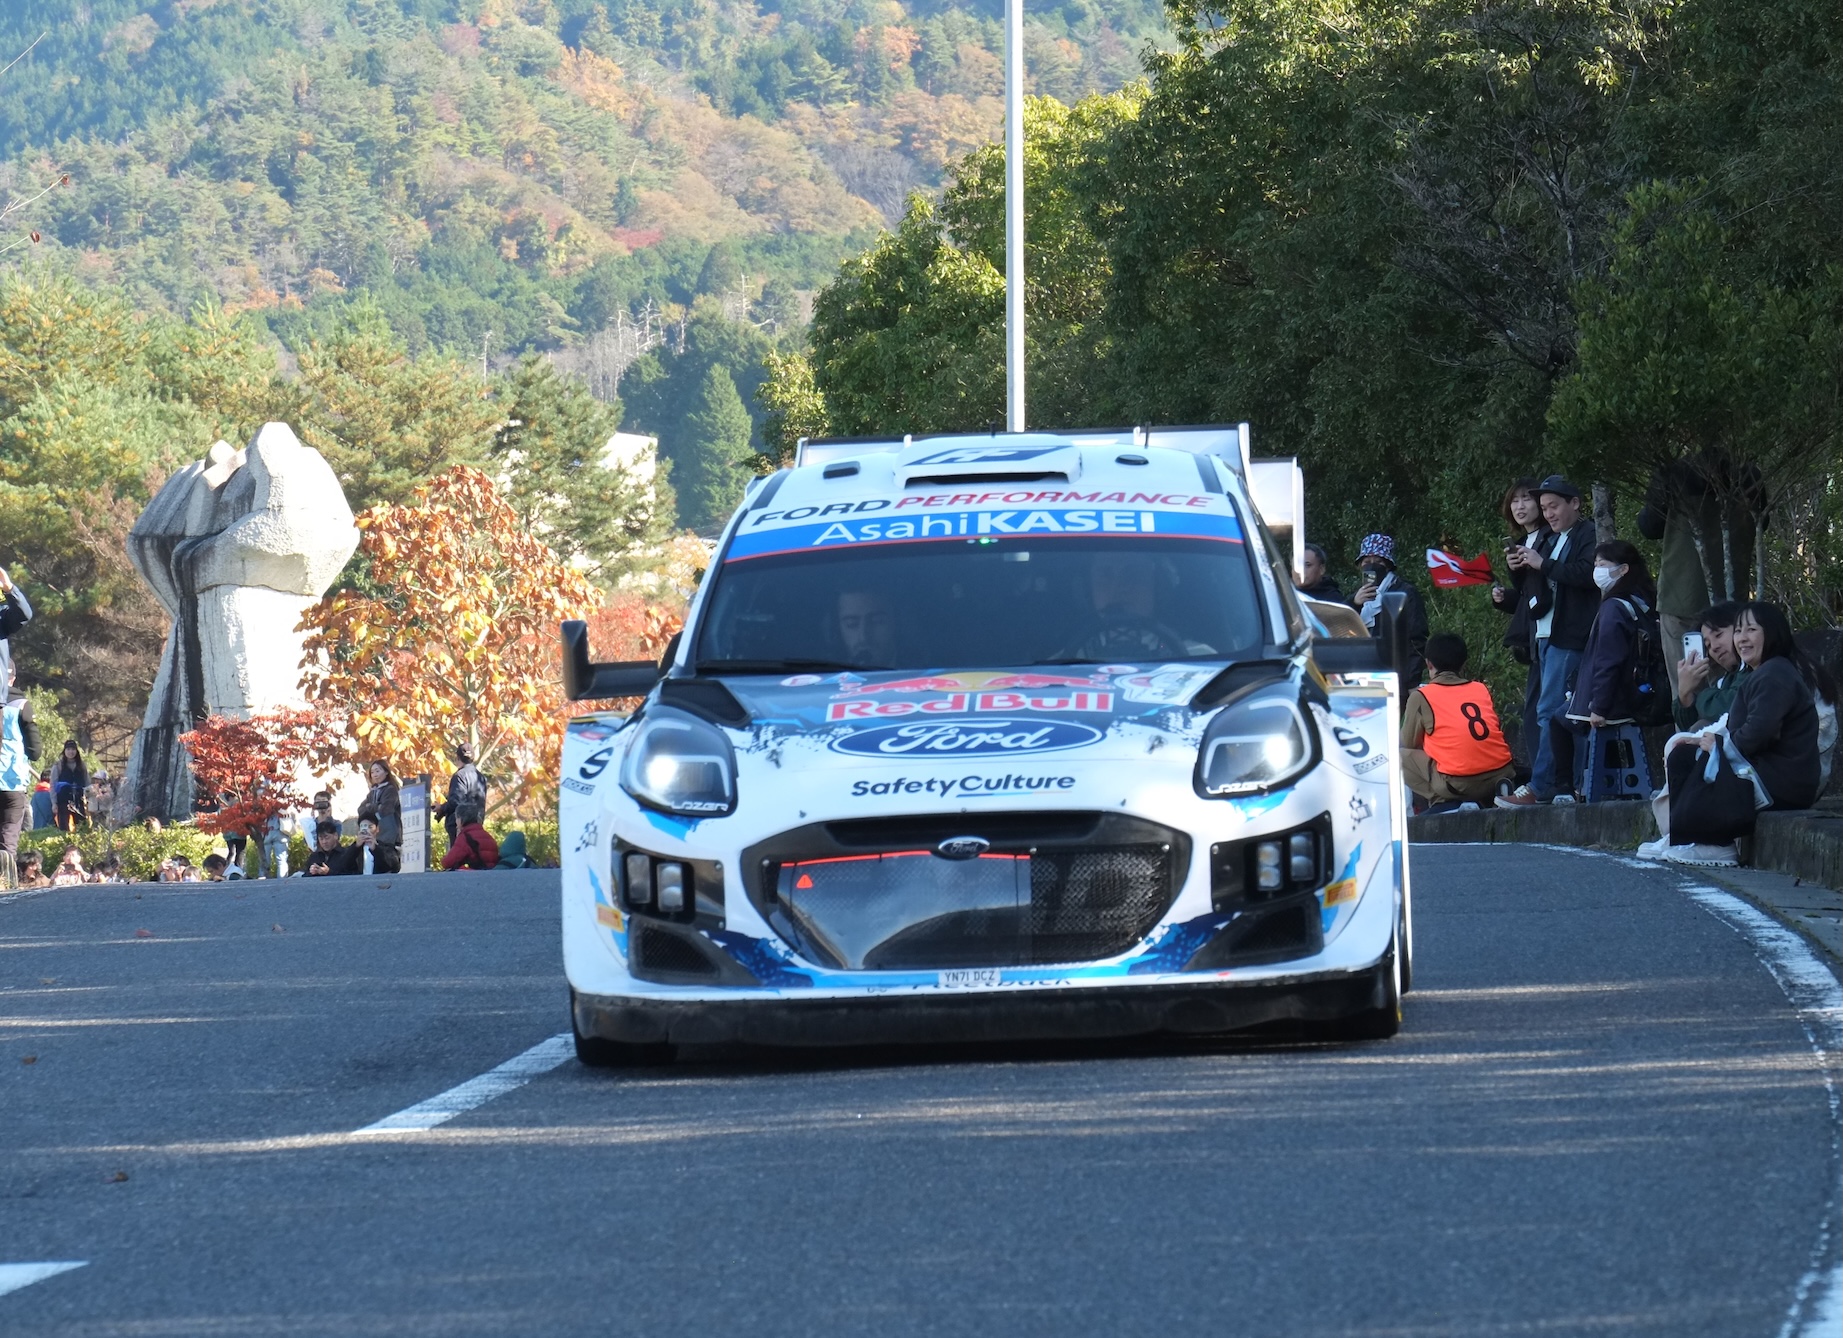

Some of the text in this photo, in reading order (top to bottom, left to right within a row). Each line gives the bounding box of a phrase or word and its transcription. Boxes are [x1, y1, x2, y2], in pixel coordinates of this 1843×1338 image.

[752, 491, 1214, 526] FORD PERFORMANCE
[826, 692, 1114, 722] Red Bull
[1460, 702, 1490, 741] 8
[878, 721, 1056, 753] Ford
[851, 774, 1076, 798] SafetyCulture
[973, 969, 996, 982] DCZ
